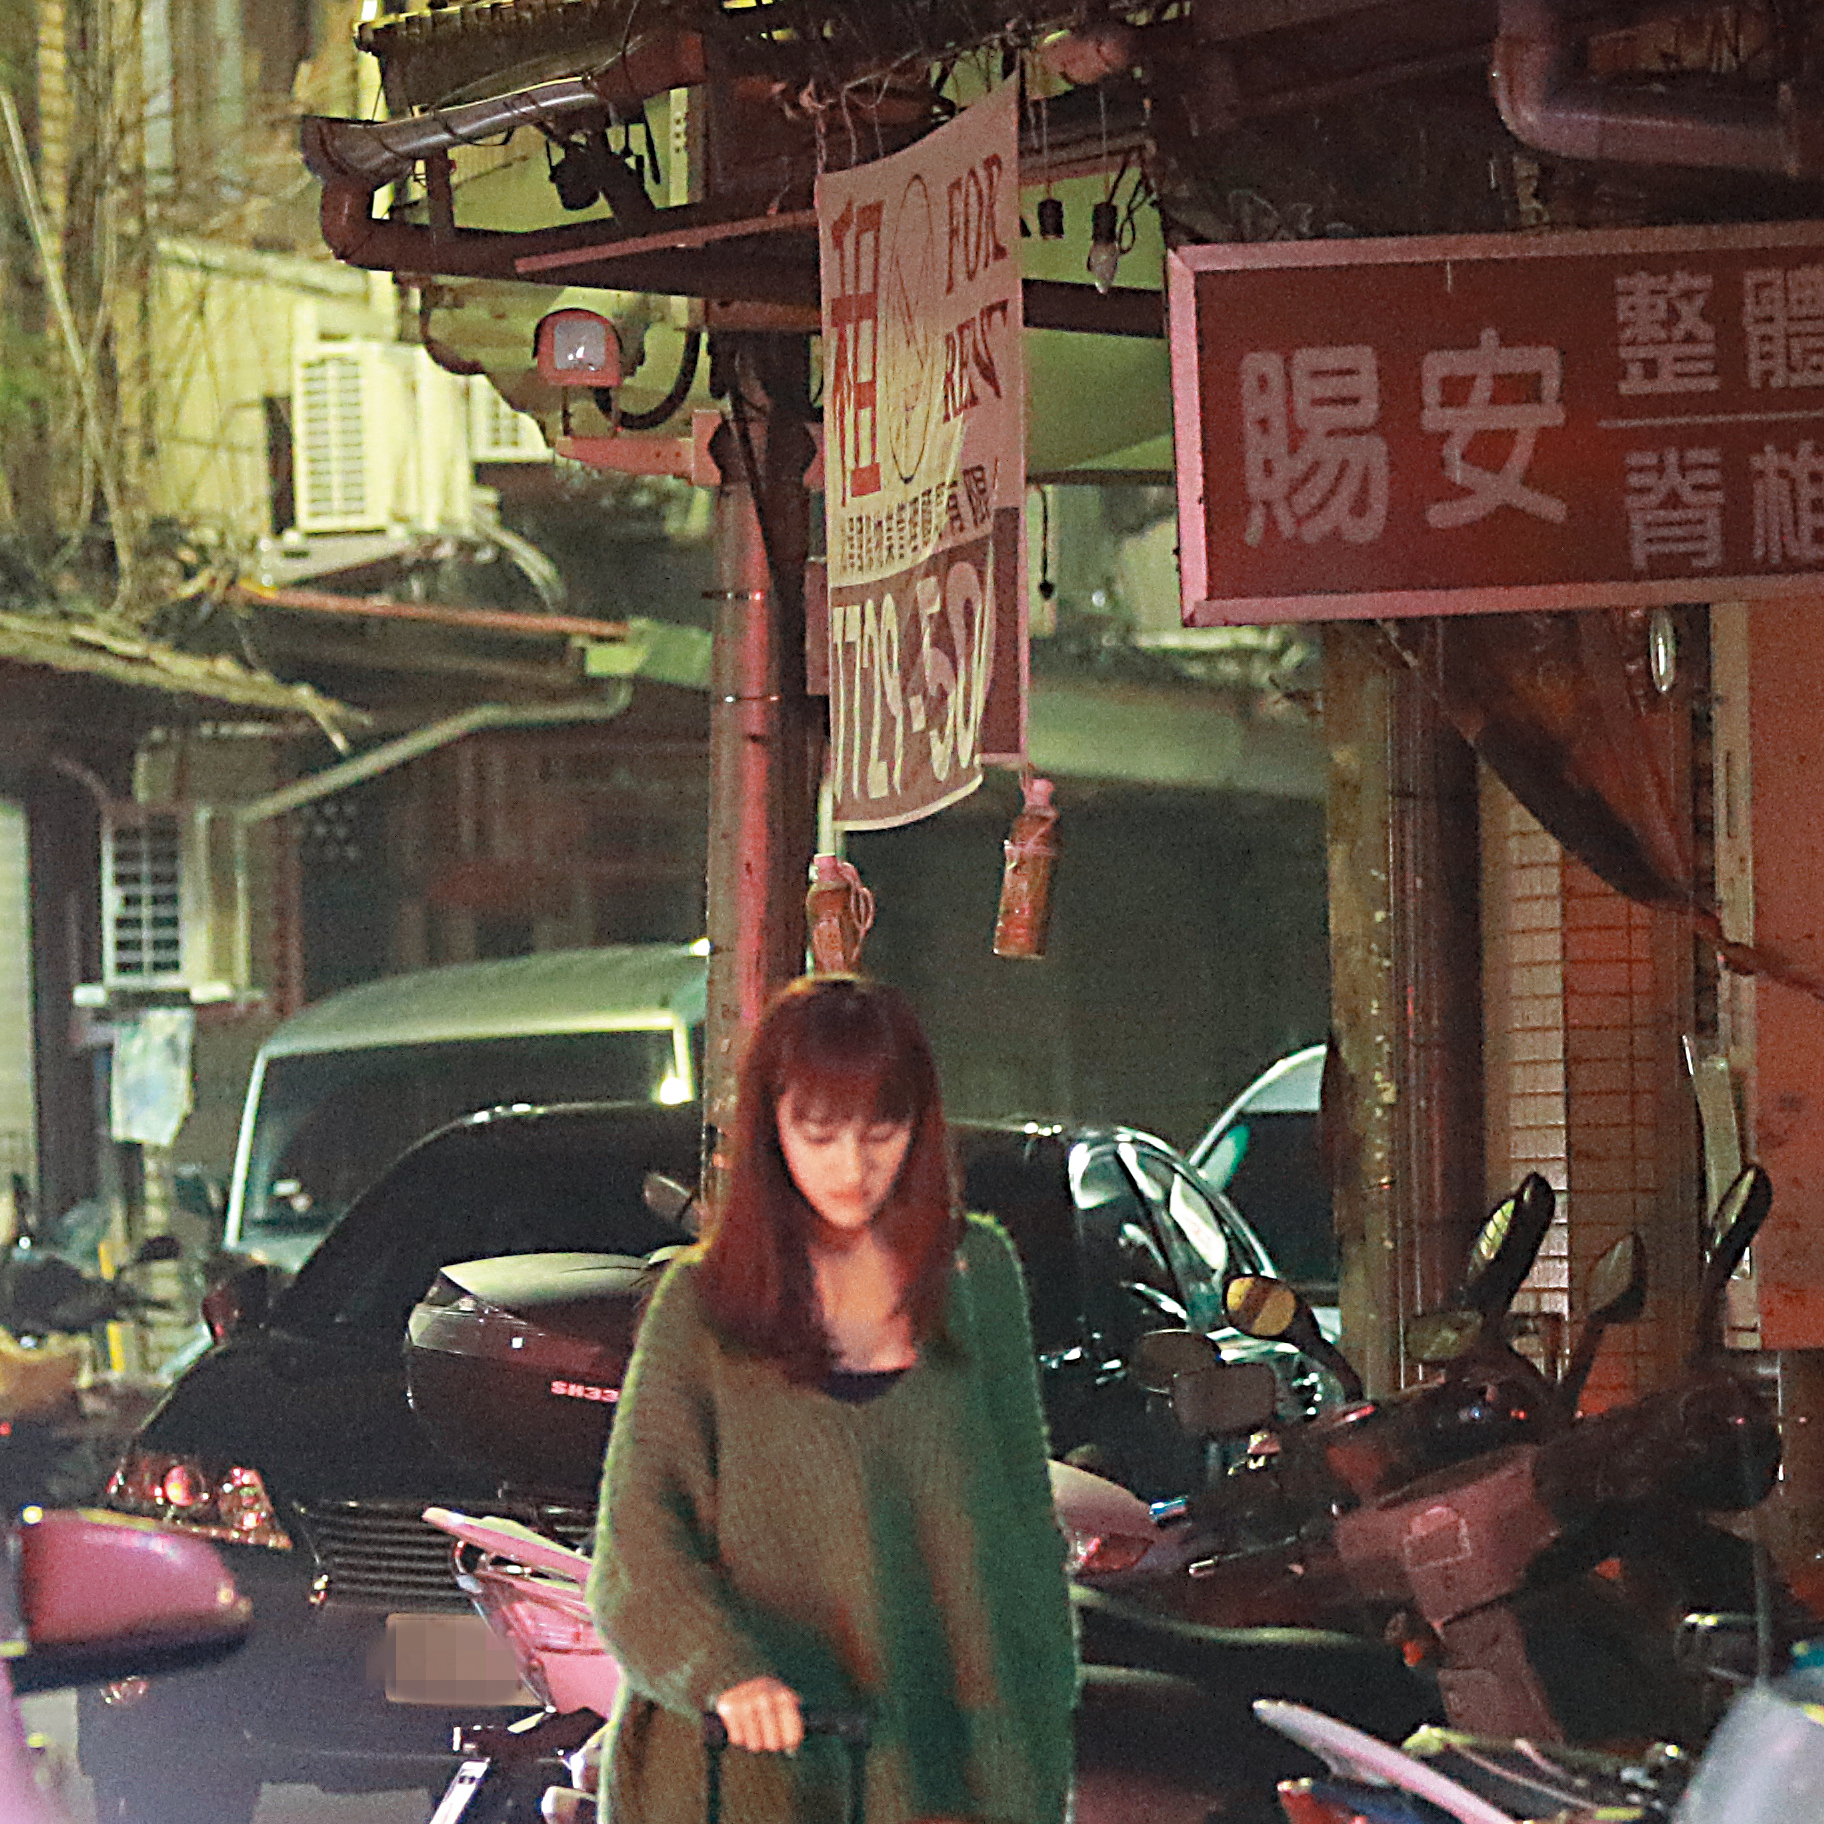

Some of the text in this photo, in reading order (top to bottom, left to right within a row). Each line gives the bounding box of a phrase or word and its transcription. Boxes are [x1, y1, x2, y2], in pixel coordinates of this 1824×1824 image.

[945, 152, 1009, 296] FOR
[829, 199, 884, 507] 租
[1238, 325, 1569, 549] 賜安
